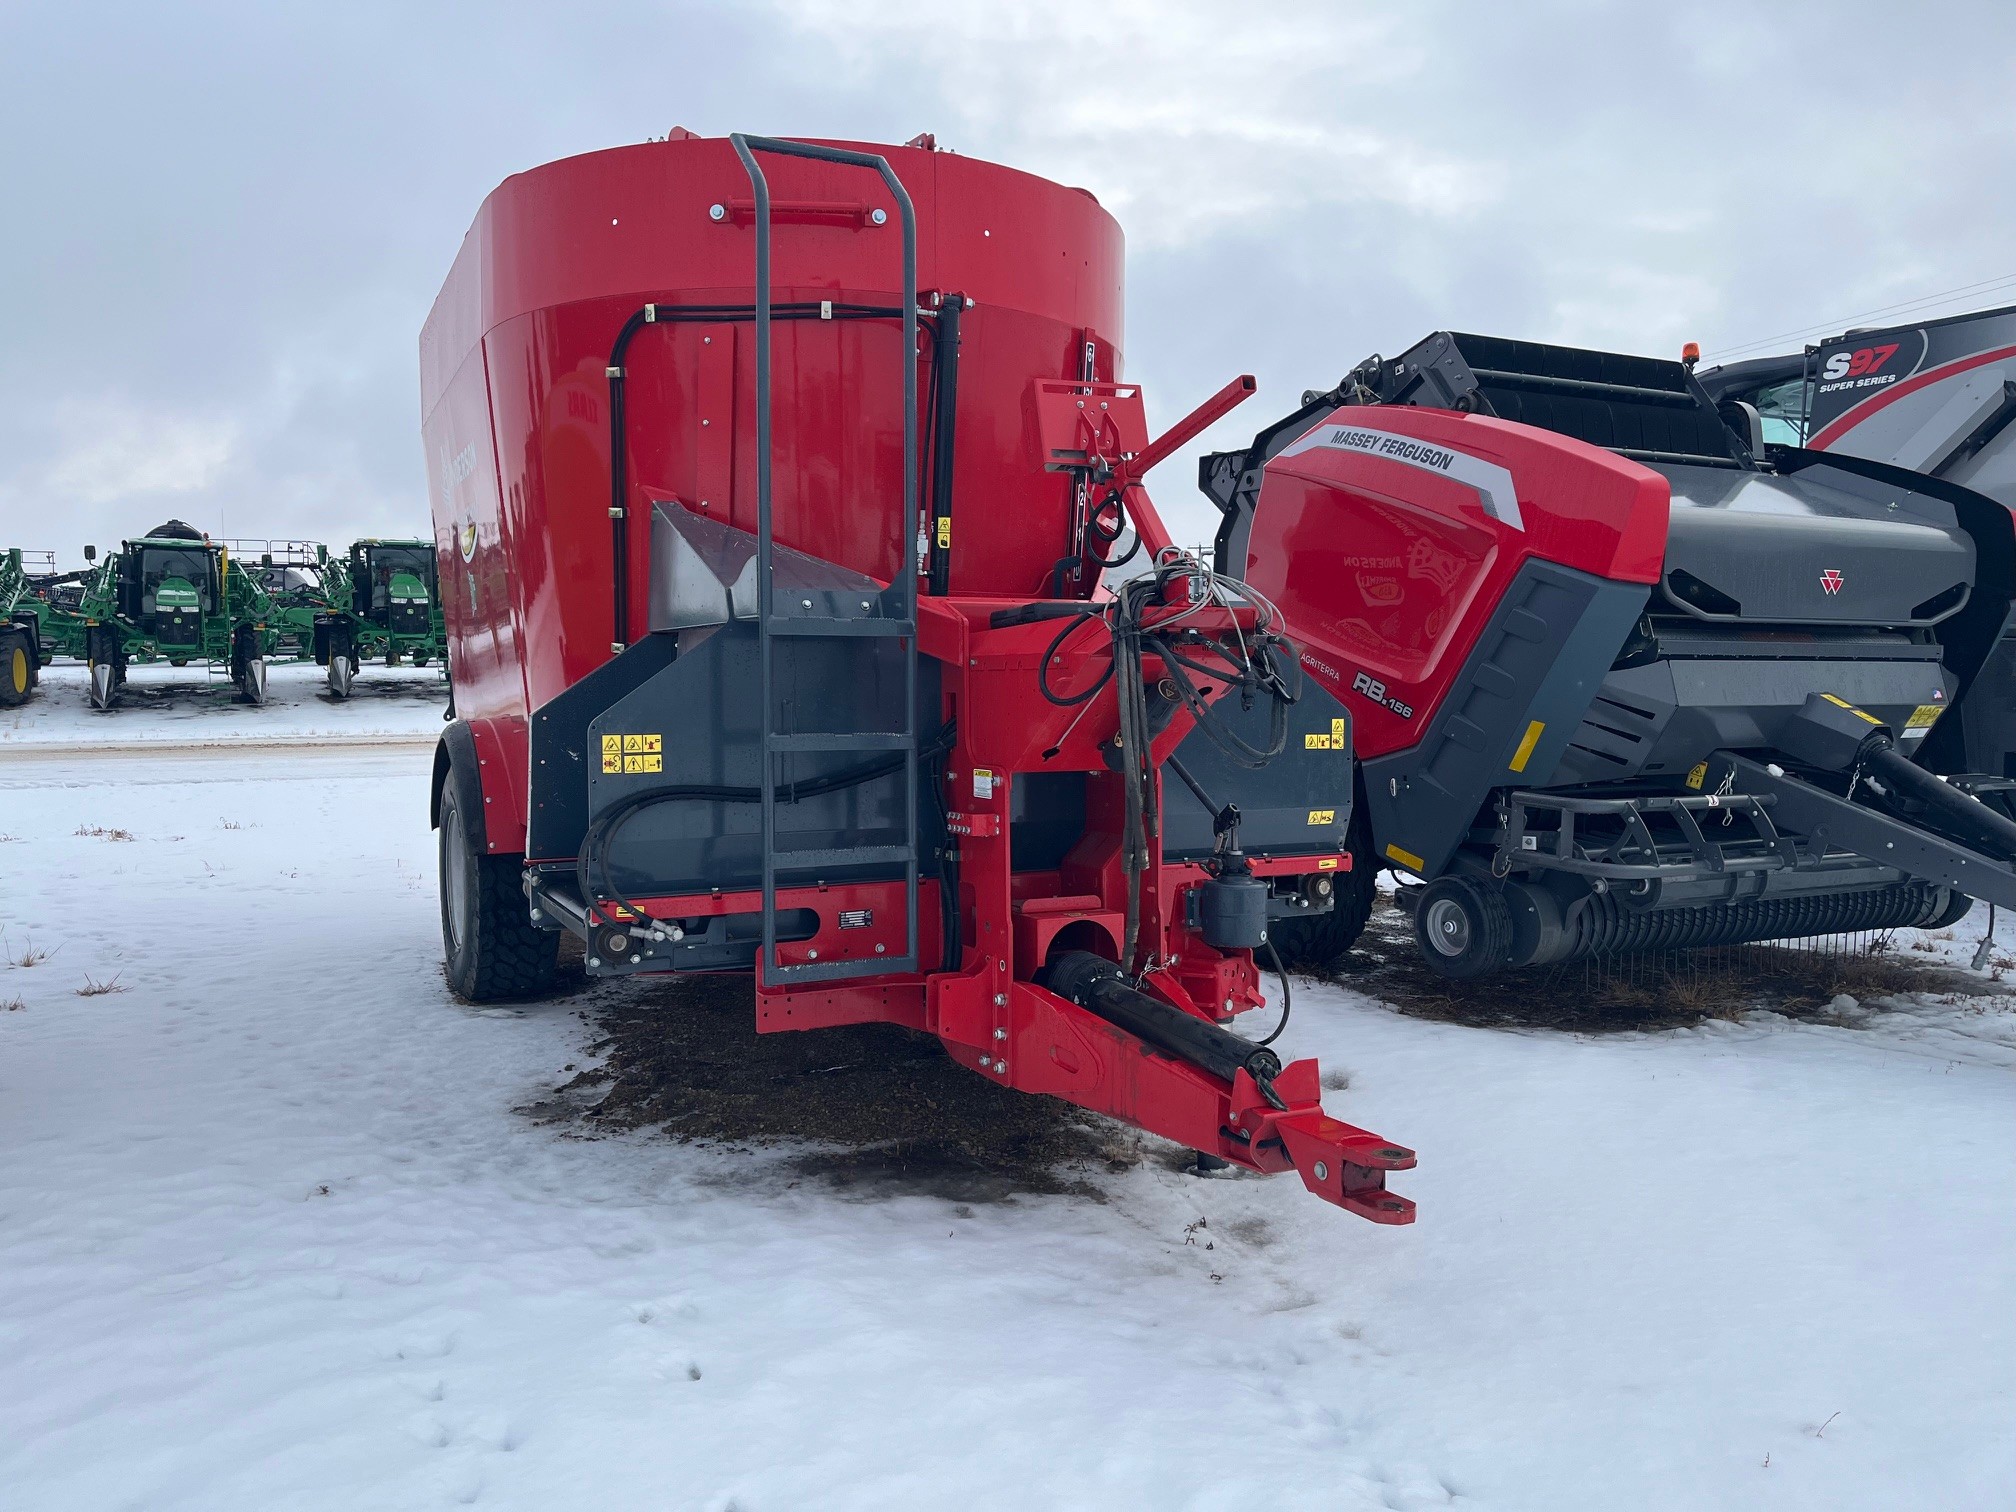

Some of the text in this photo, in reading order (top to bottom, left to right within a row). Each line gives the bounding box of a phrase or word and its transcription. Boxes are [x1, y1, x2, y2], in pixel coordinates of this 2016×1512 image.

[1822, 343, 1900, 380] S97
[1819, 374, 1896, 393] SUPER SERIES
[1330, 430, 1455, 470] MASSEY FERGUSON
[1300, 653, 1340, 681] AGRITERRA
